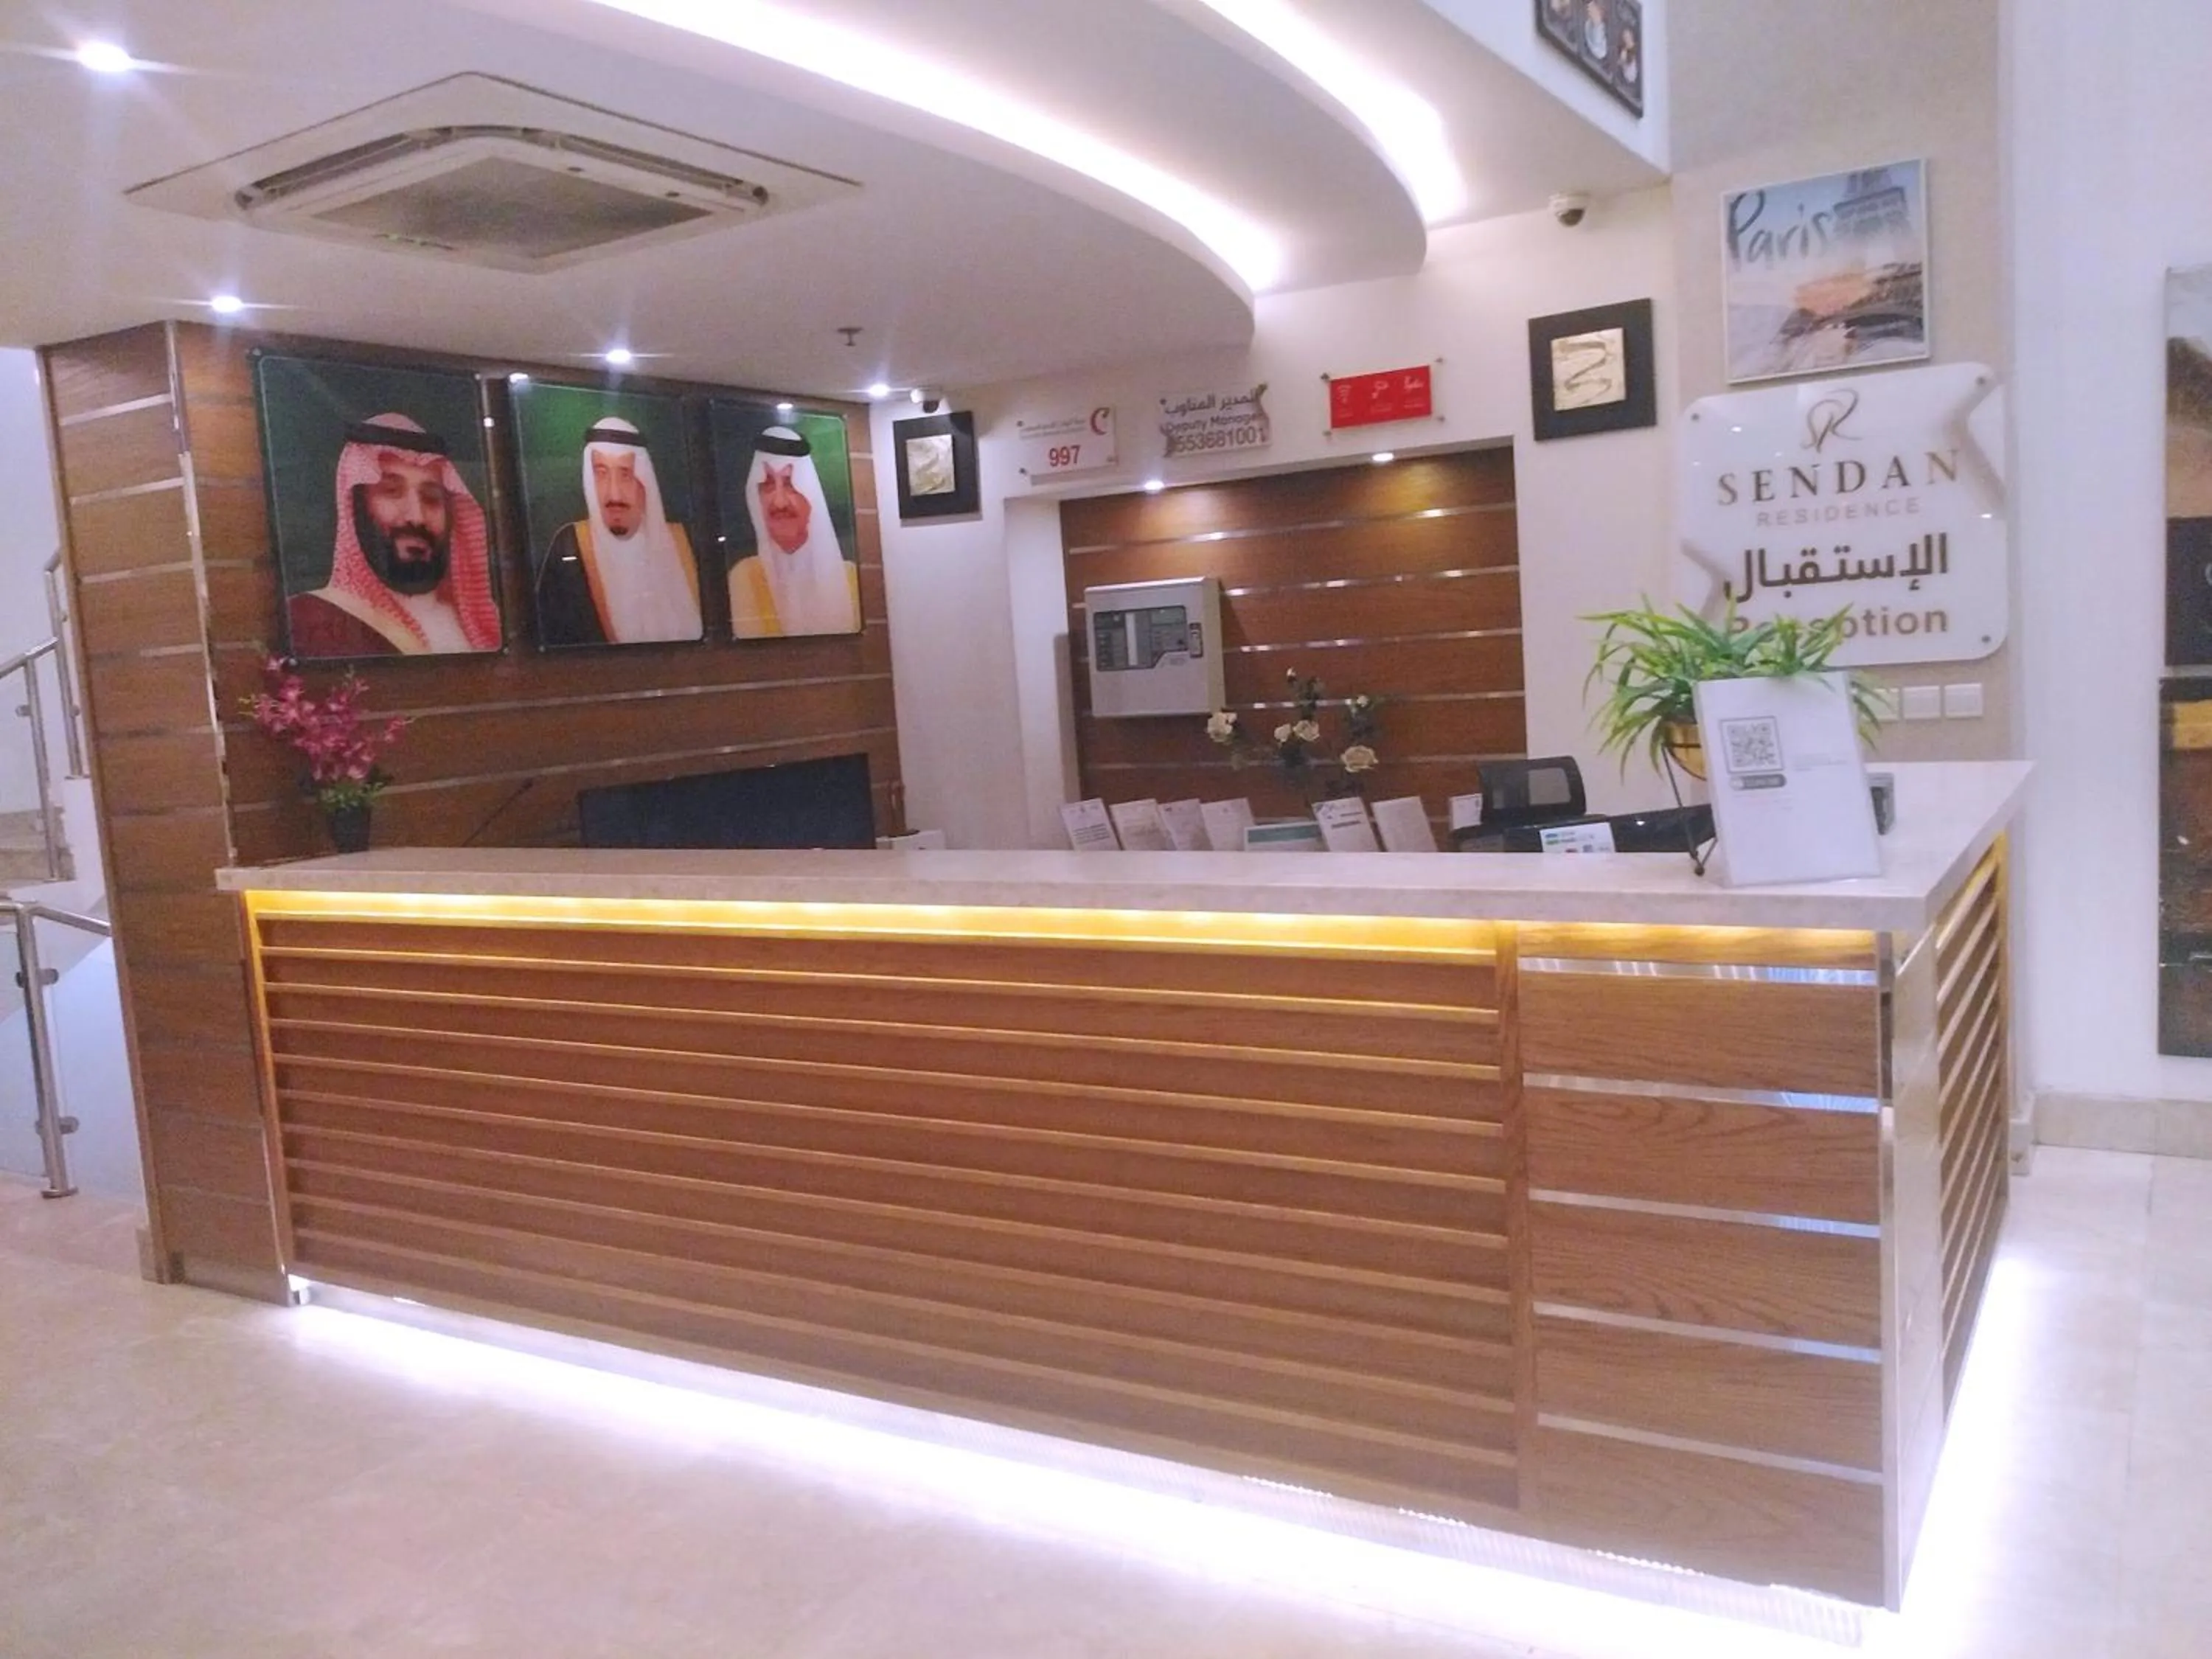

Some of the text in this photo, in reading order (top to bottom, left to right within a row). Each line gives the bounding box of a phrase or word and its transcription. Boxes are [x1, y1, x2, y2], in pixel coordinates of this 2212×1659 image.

[1727, 188, 1833, 273] Paris
[1048, 445, 1081, 467] 997
[1166, 425, 1267, 453] 553681001
[1717, 448, 1960, 507] SENDAN
[1756, 496, 1921, 527] RESIDENCE
[1723, 532, 1948, 602] الإستقبال
